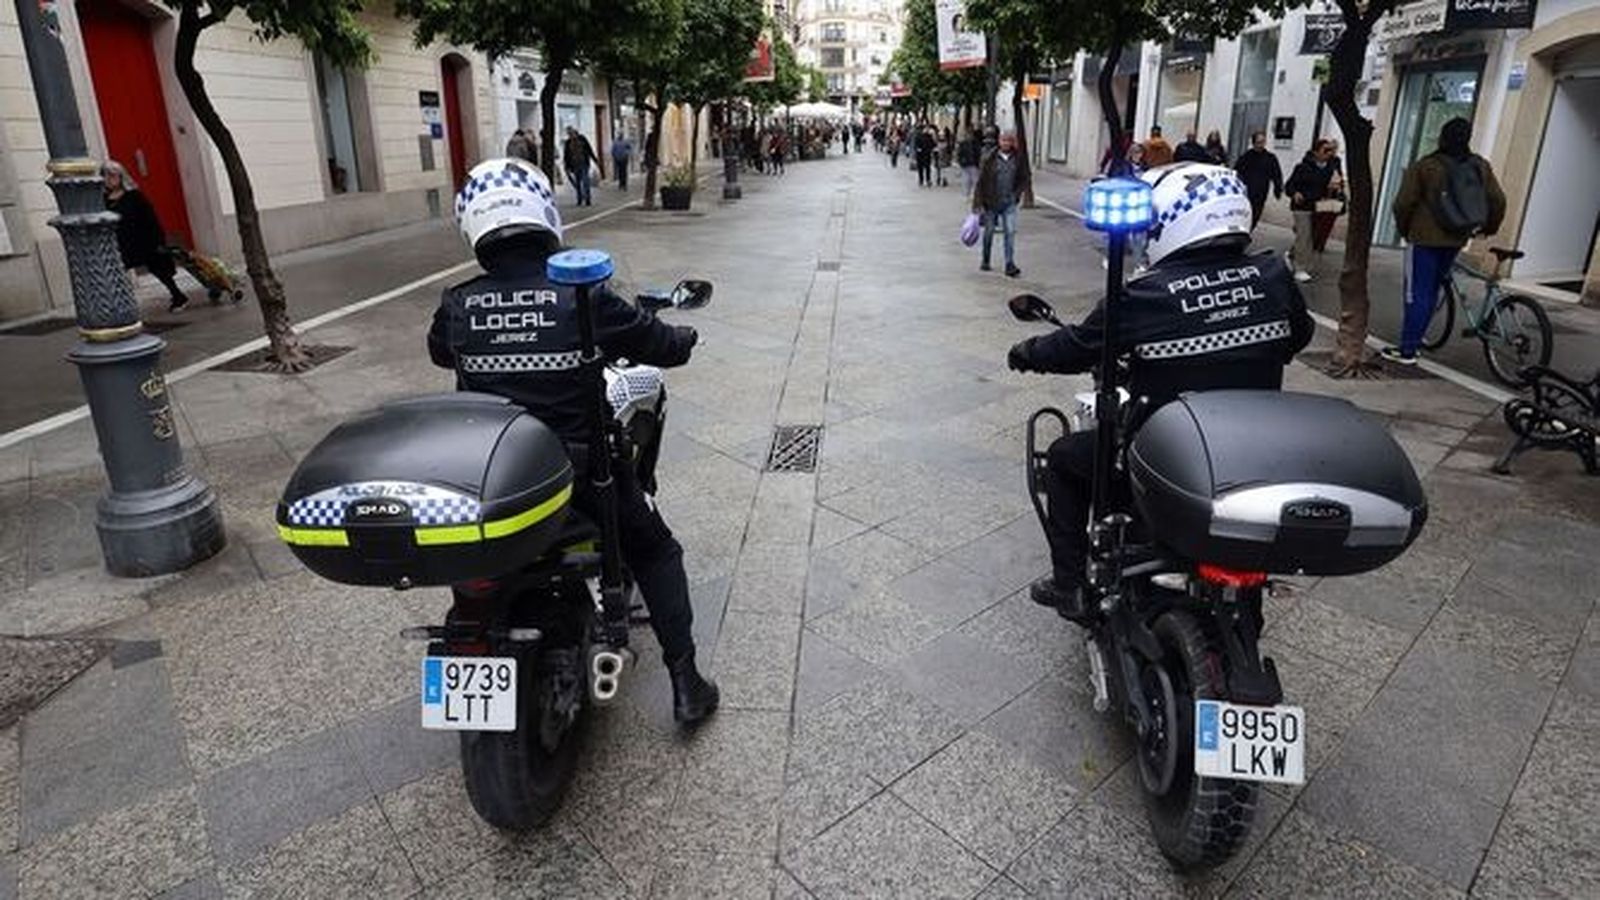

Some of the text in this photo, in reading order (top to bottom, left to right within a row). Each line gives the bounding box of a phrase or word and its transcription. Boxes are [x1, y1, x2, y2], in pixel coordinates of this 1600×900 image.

[1168, 266, 1261, 294] POLICIA
[464, 290, 557, 309] POLICIA
[1181, 286, 1265, 313] LOCAL
[470, 312, 557, 330] LOCAL
[1204, 306, 1249, 324] JEREZ
[490, 332, 538, 344] JEREZ
[445, 663, 511, 692] 9739
[445, 693, 493, 722] LTT
[1222, 708, 1298, 744] 9950
[1231, 743, 1287, 777] LKW
